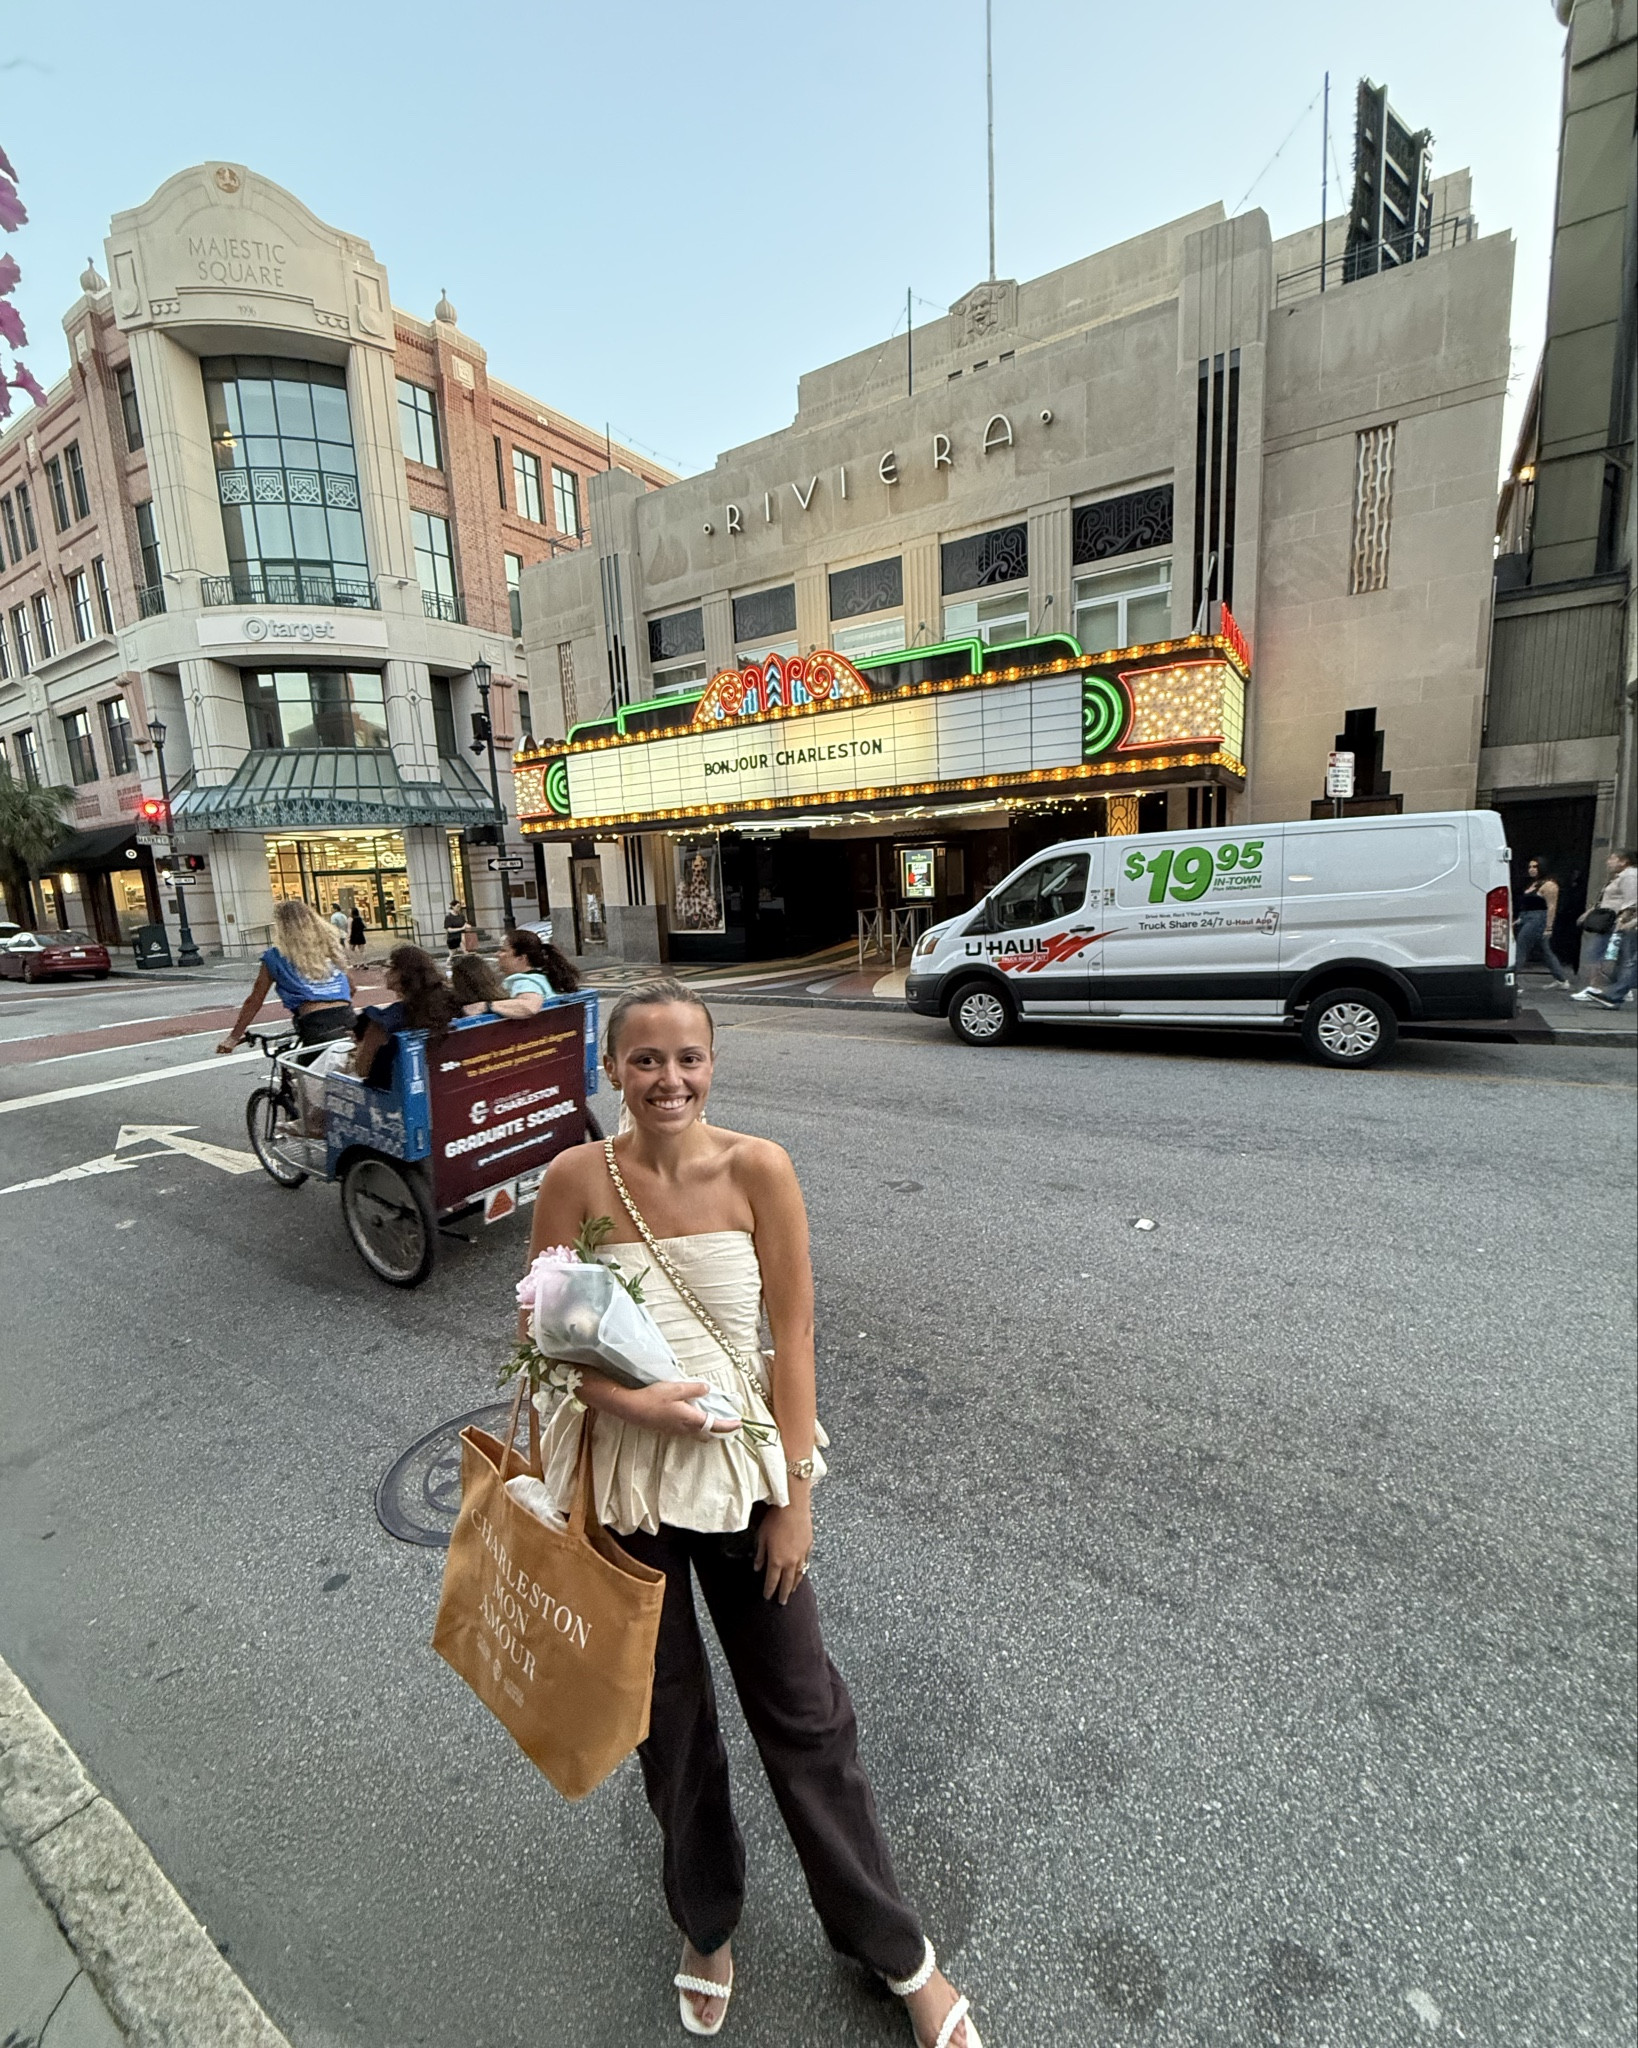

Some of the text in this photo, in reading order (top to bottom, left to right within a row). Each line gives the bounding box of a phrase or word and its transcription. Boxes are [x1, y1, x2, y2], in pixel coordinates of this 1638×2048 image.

[188, 236, 286, 264] MAJESTIC
[198, 261, 284, 287] SQUARE
[726, 413, 1013, 534] RIVIERA
[268, 619, 336, 642] target
[704, 738, 883, 776] BONJOUR CHARLESTON
[1213, 874, 1262, 887] IN-TOWN
[1138, 917, 1272, 931] Truck Share 24/7 U-Haul App
[493, 1085, 559, 1115] CHARLESTON
[444, 1117, 525, 1159] GRADUATE
[527, 1099, 578, 1128] SCHOOL
[471, 1508, 593, 1650] CHARLESTON
[492, 1573, 529, 1636] MON
[478, 1593, 537, 1682] AMOUR
